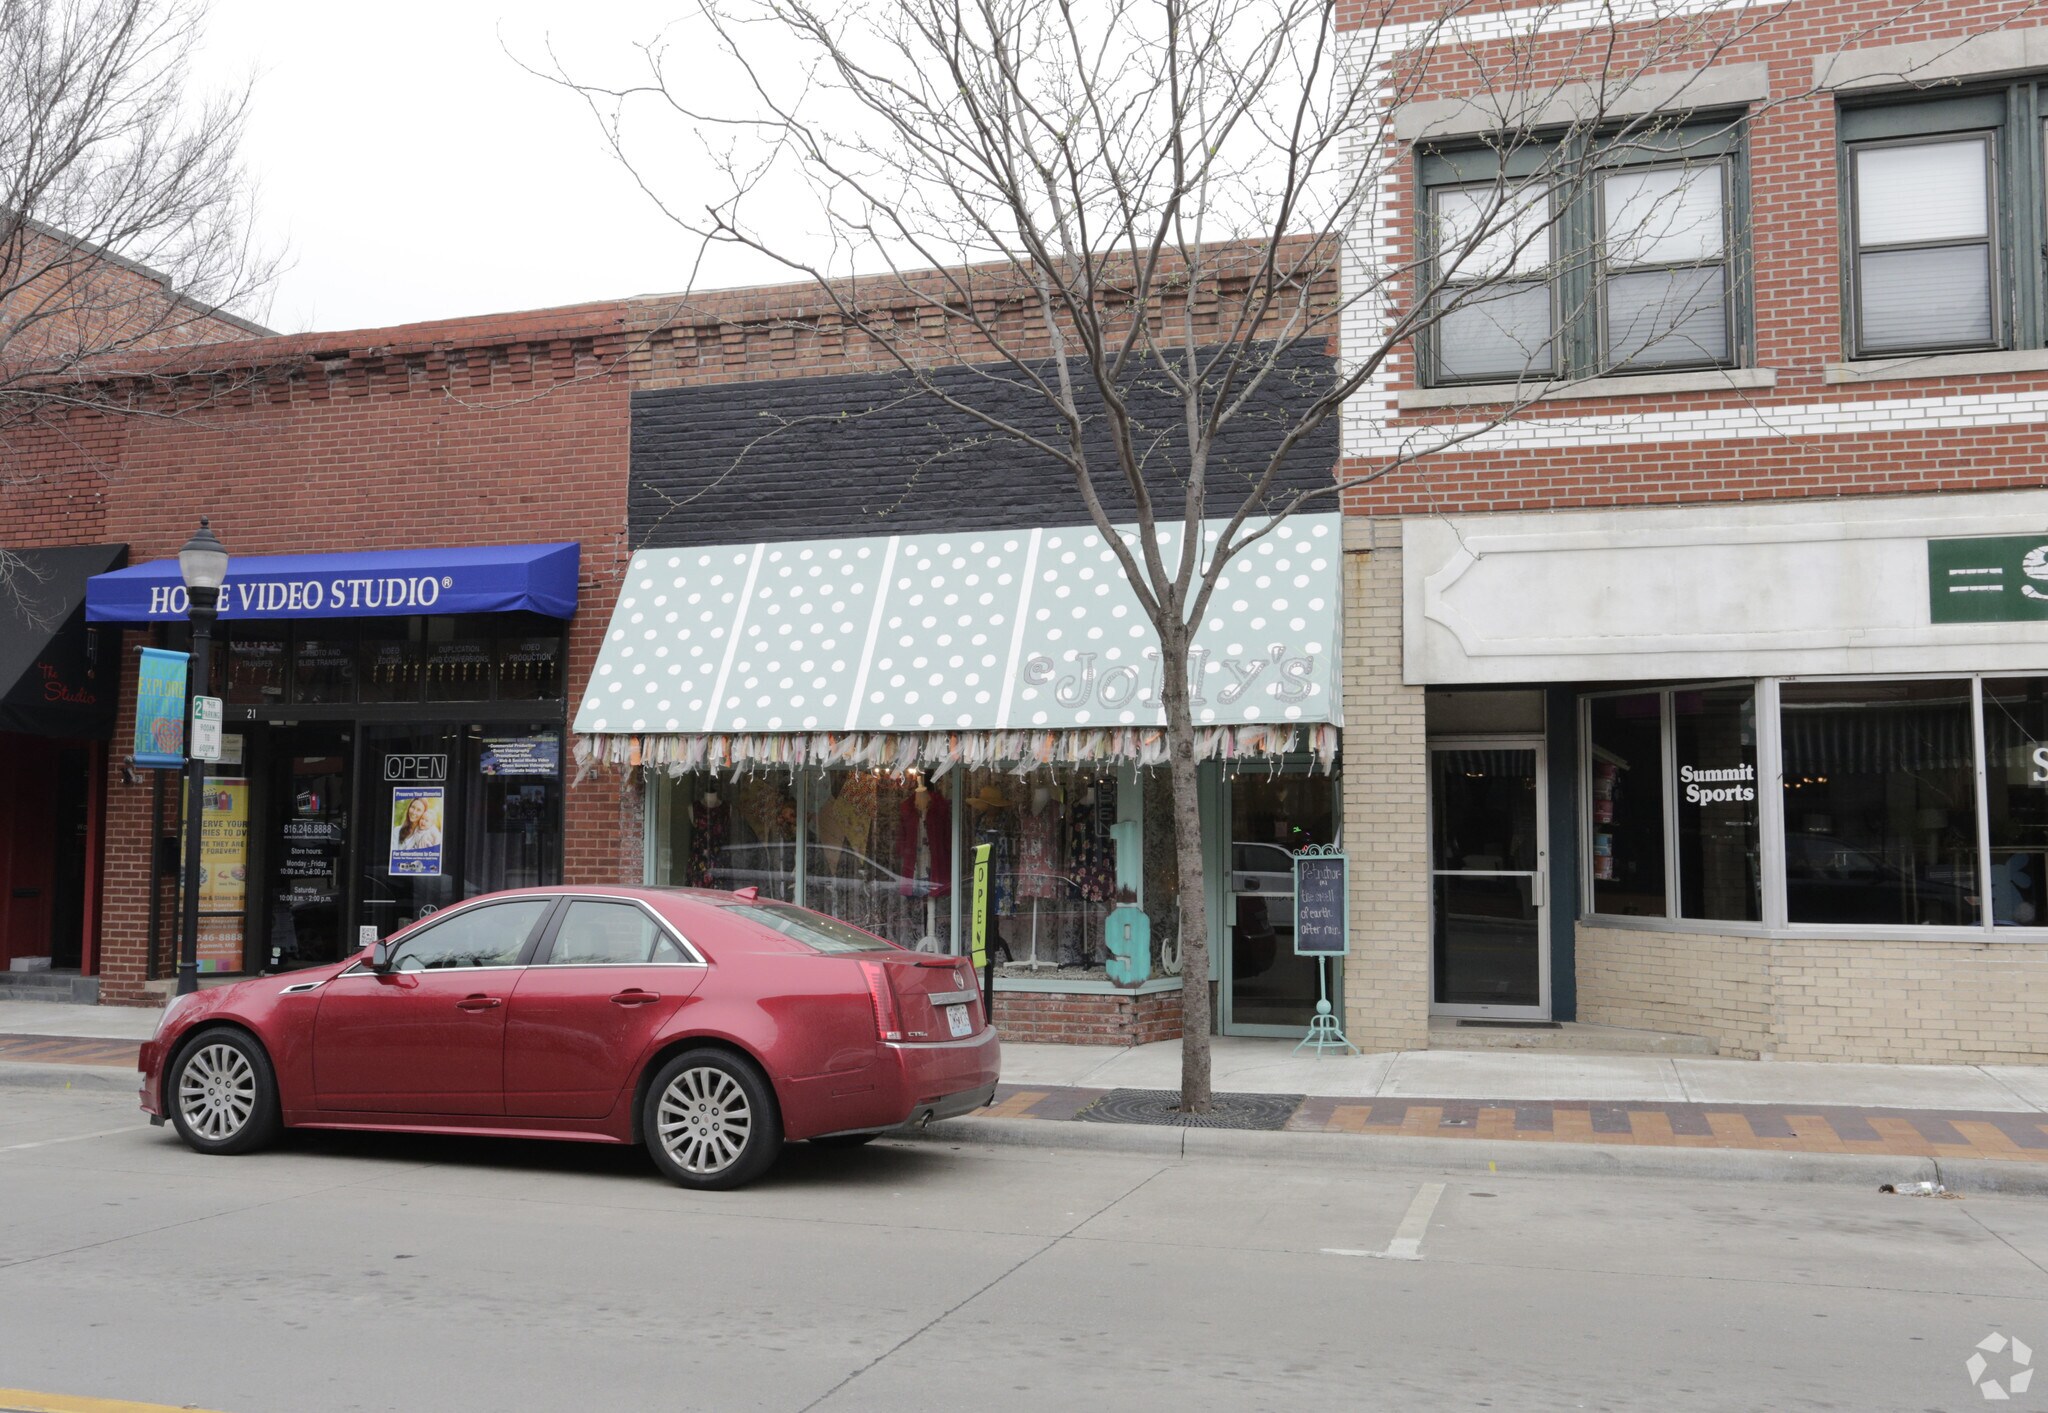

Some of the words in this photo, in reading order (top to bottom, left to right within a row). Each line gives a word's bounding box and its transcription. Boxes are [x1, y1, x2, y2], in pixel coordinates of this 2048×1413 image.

[149, 585, 230, 613] HOE
[237, 580, 323, 611] VIDEO
[305, 649, 327, 657] PHOTO
[328, 648, 341, 656] AND
[438, 645, 480, 653] DUPLICATION
[520, 643, 540, 651] VIDEO
[298, 659, 317, 667] SLIDE
[317, 658, 348, 666] TRANSFER
[429, 656, 444, 664] AND
[444, 655, 489, 663] CONVERSIONS
[509, 652, 552, 662] PRODUCTION
[242, 660, 273, 668] TRANSFER
[38, 662, 58, 679] The
[44, 681, 97, 705] Studio
[138, 676, 186, 699] EXPLORE
[195, 700, 203, 716] 2
[246, 708, 256, 720] 21
[202, 710, 220, 719] PARKING
[387, 757, 445, 778] OPEN
[1681, 763, 1754, 783] Summit
[1686, 784, 1754, 806] Sports
[284, 825, 332, 834] 816.246.8888
[286, 860, 307, 868] Monday
[310, 860, 327, 868] Friday
[294, 886, 318, 895] Saturday
[1301, 890, 1314, 903] the
[1315, 889, 1335, 902] smell
[976, 867, 984, 944] OPEN
[1301, 906, 1309, 919] of
[1309, 907, 1333, 919] earth
[1301, 923, 1322, 935] after
